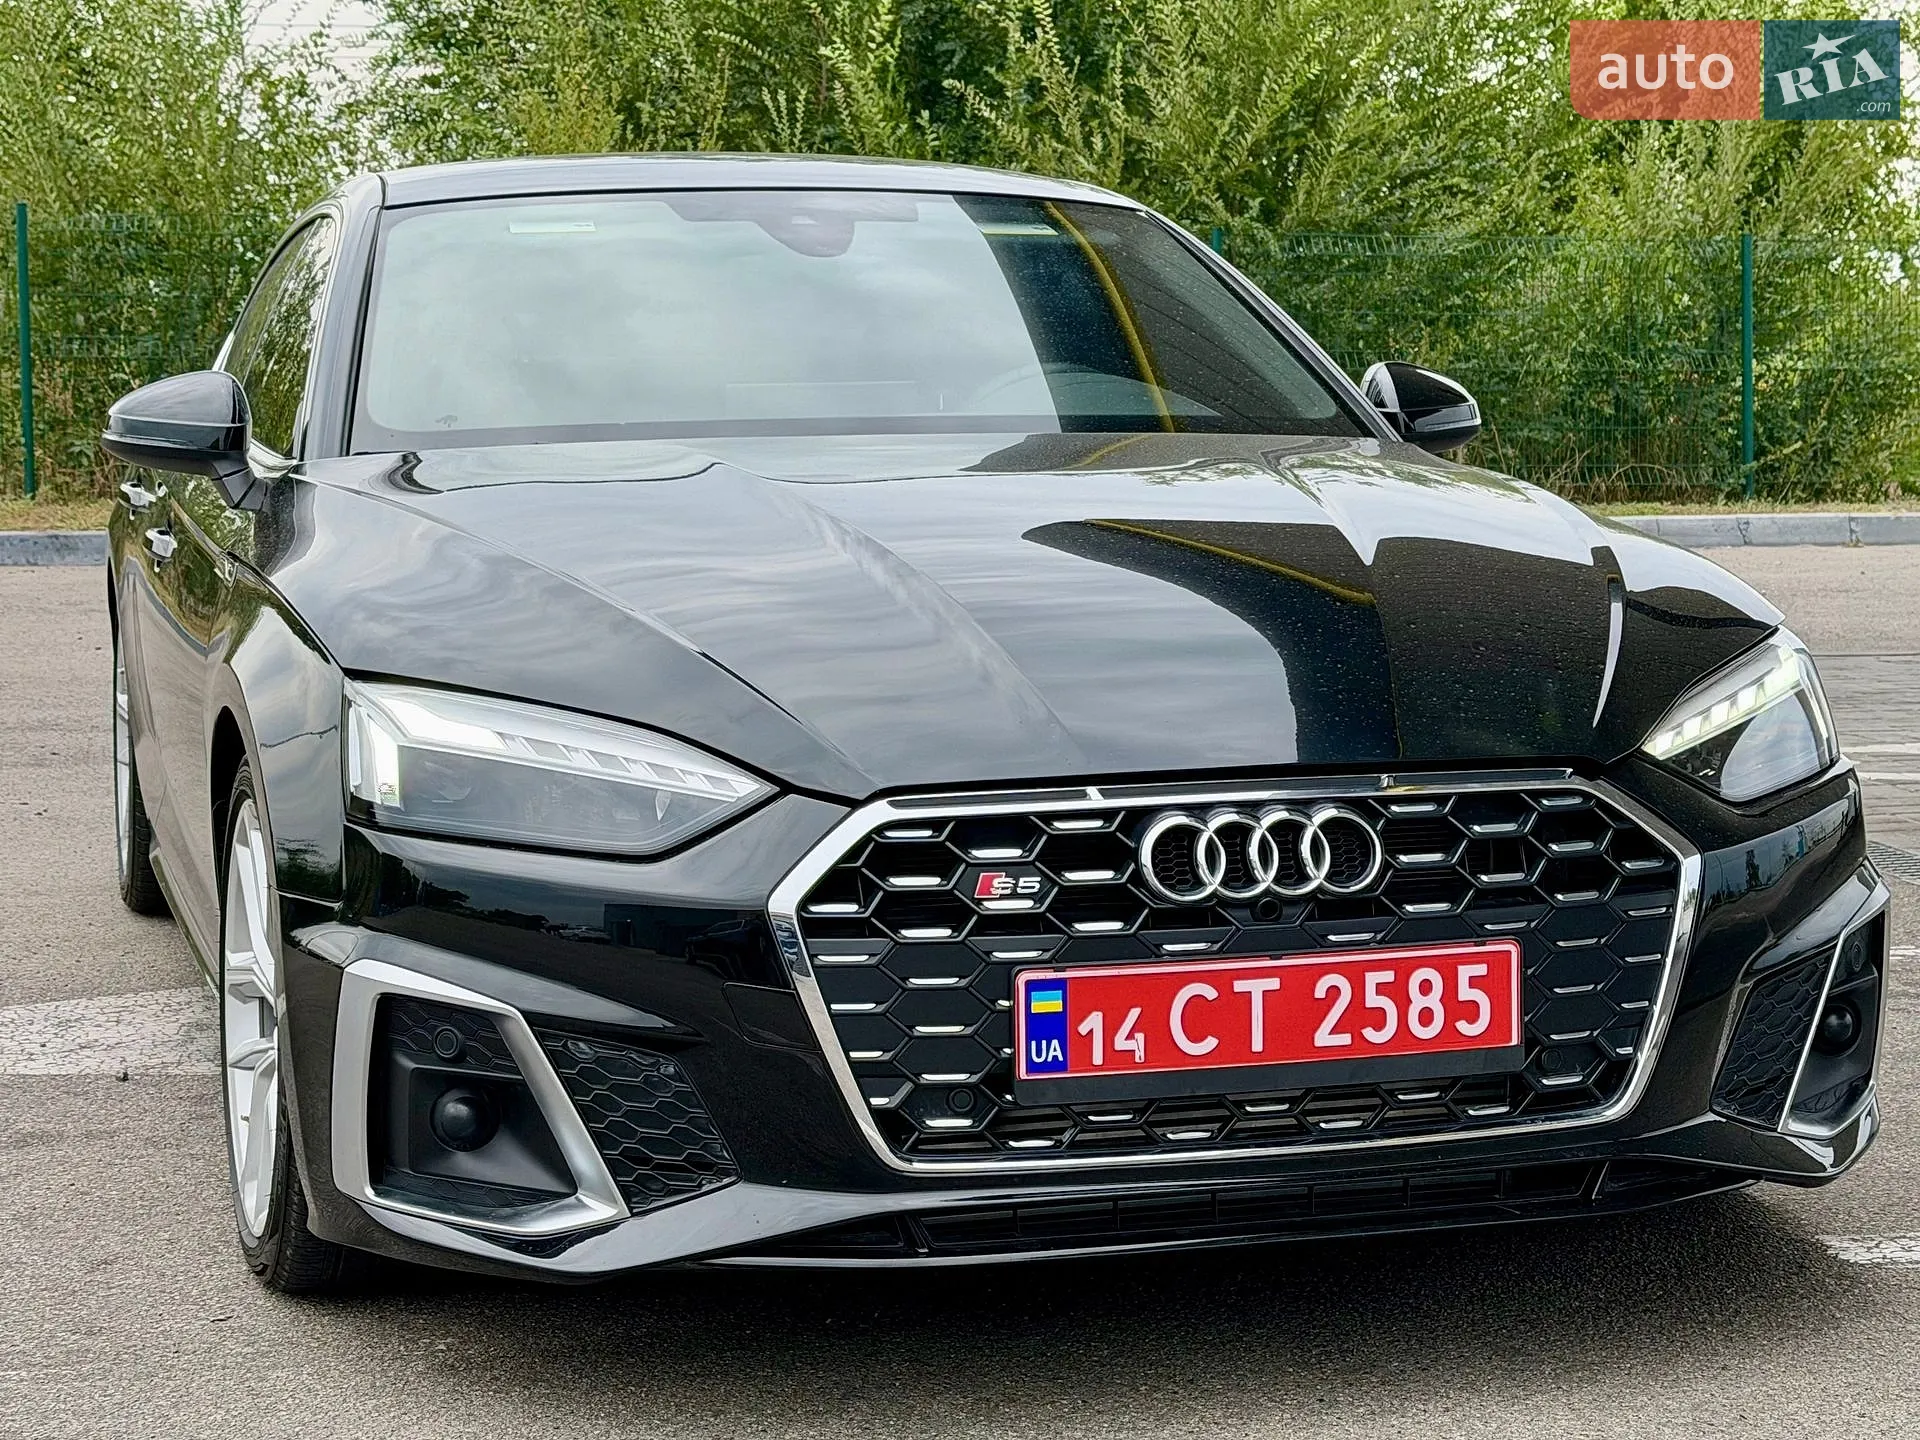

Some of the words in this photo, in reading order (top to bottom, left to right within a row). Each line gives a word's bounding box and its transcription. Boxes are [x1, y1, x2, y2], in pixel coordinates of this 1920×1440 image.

[989, 876, 1042, 895] S5
[1076, 1007, 1145, 1065] 14
[1313, 963, 1492, 1047] 2585
[1031, 1039, 1064, 1063] UA
